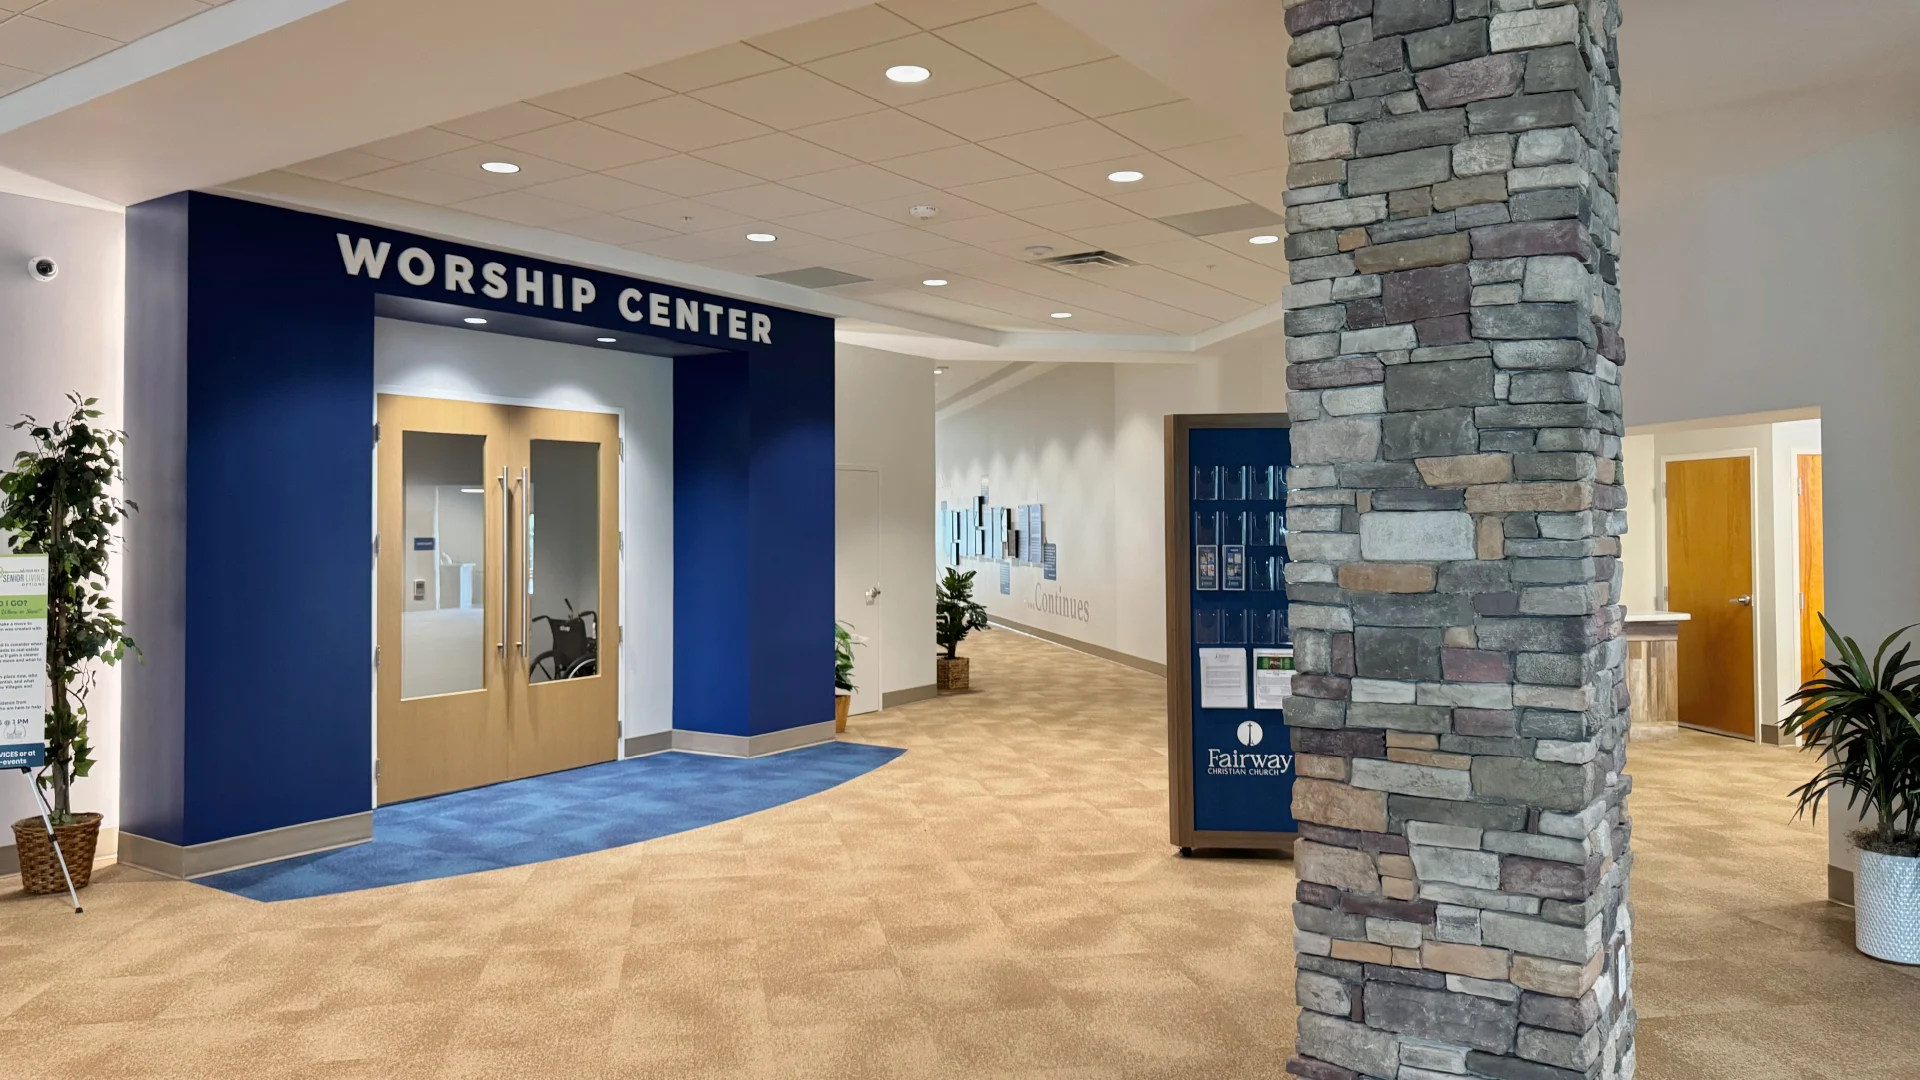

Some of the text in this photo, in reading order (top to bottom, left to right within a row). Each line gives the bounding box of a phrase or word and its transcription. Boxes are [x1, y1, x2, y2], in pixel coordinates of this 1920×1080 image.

[336, 233, 773, 345] WORSHIP CENTER
[2, 573, 45, 583] SENIOR LIVING
[10, 599, 28, 607] GO?
[28, 749, 36, 757] at
[1208, 749, 1293, 773] Fairway
[1207, 767, 1280, 776] CHRISTIAN CHURCH
